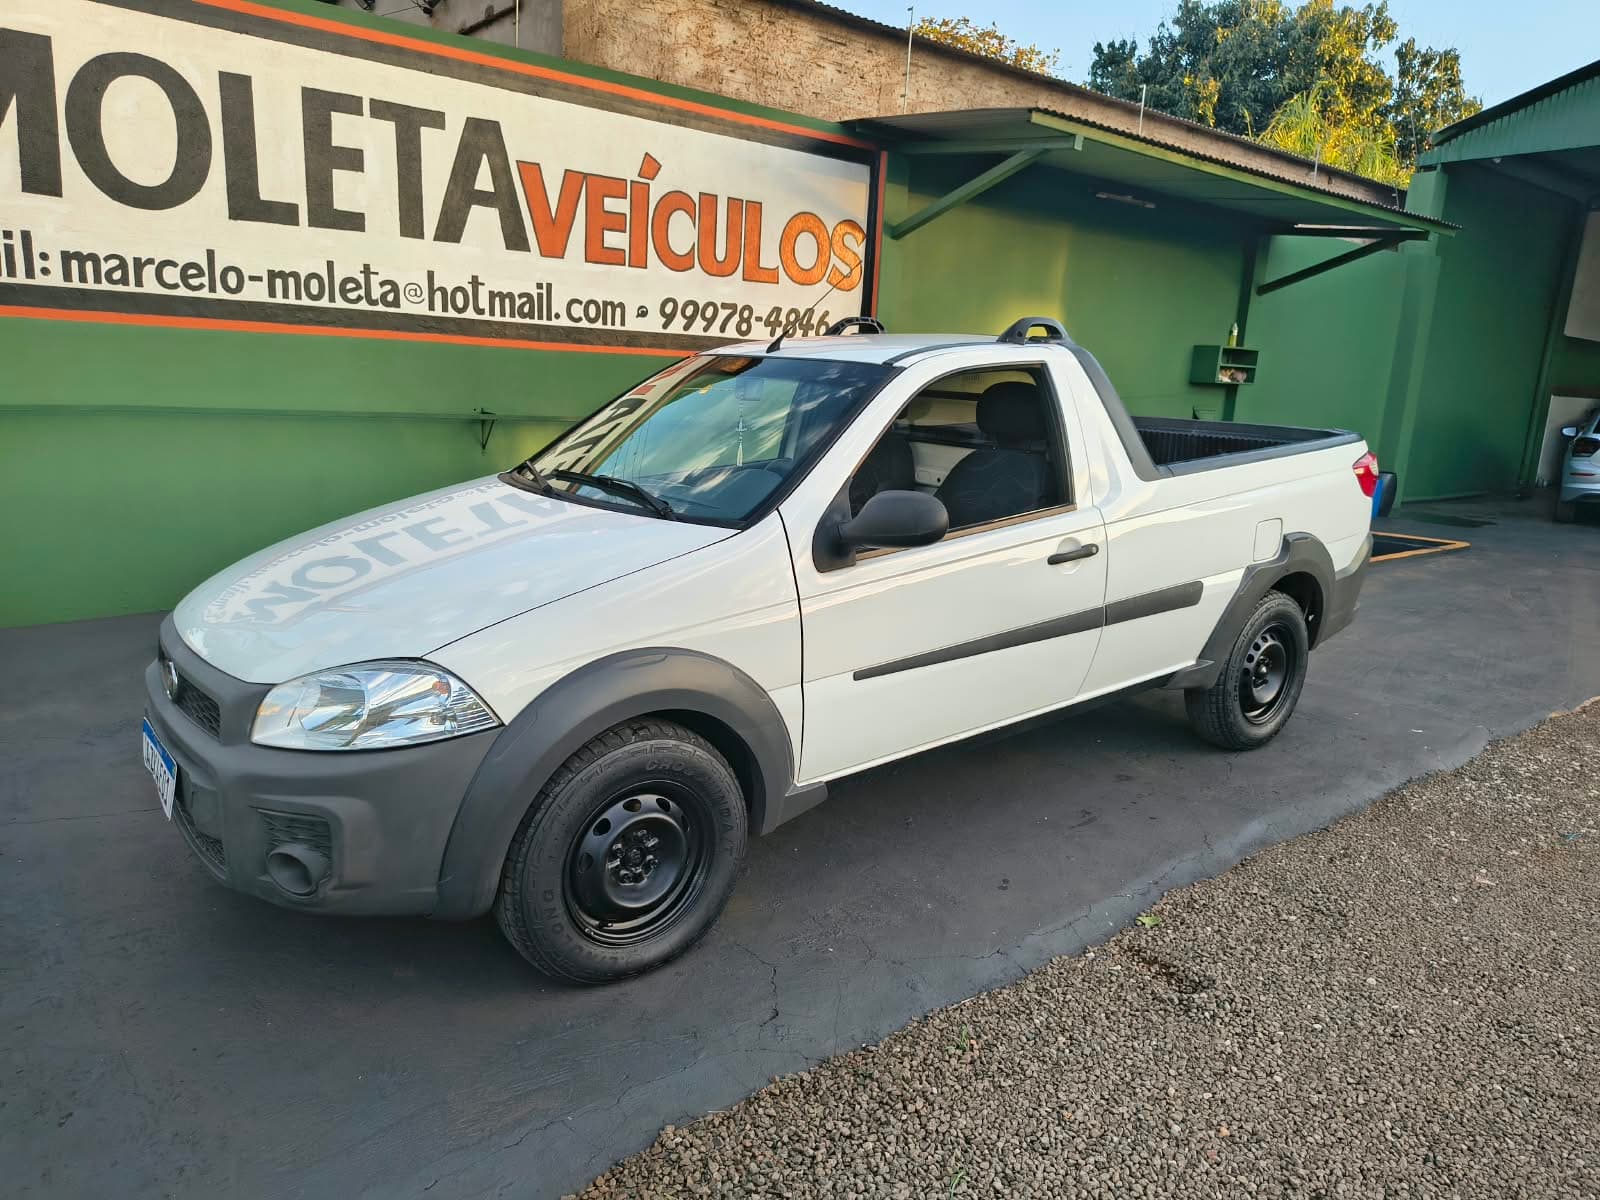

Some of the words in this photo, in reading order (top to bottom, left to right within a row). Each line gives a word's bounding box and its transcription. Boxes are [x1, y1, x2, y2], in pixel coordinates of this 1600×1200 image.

[0, 229, 52, 280] il:
[60, 248, 626, 327] marcelo-moleta@hotmail.com
[659, 297, 830, 338] 99978-4846
[516, 152, 867, 292] VEÍCULOS
